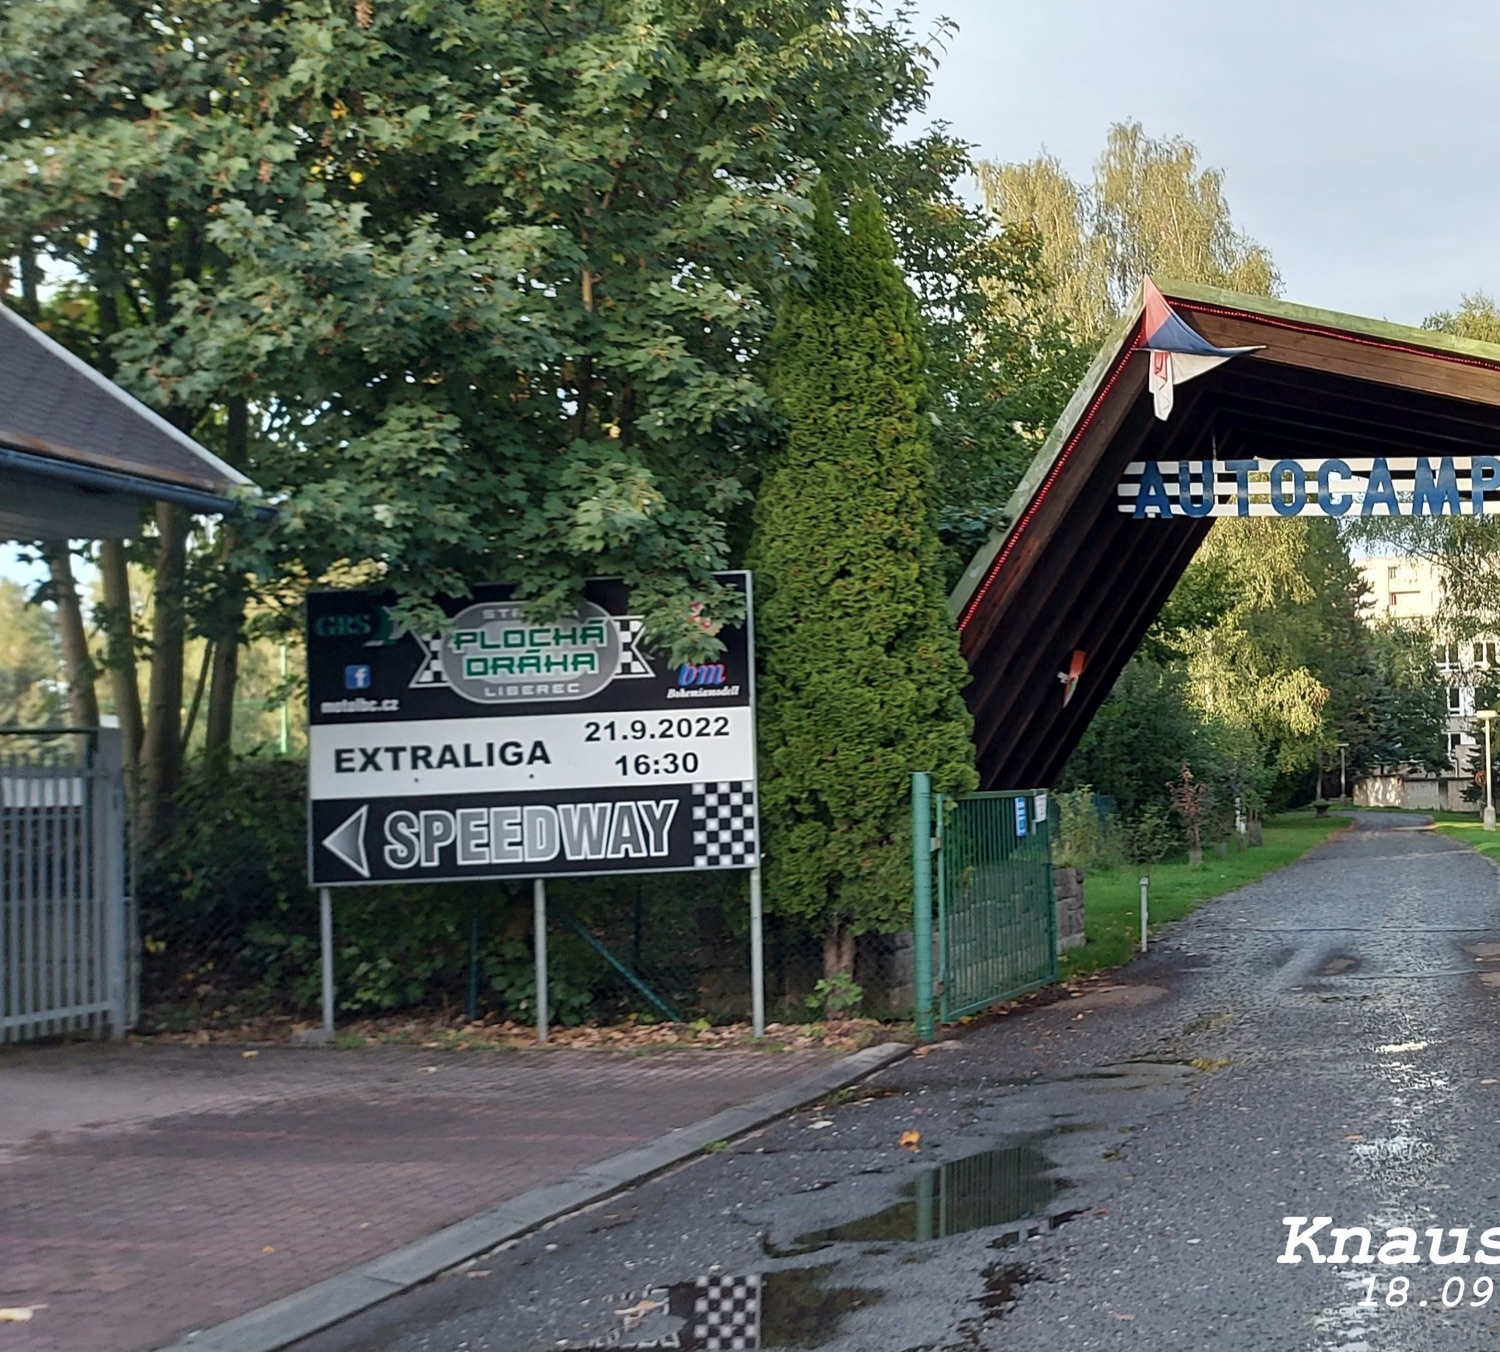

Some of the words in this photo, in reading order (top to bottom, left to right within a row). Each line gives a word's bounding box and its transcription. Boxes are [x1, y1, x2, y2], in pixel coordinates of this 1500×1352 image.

[452, 617, 606, 652] PLOCHÁ
[464, 648, 598, 678] DRÁHA
[484, 682, 580, 697] LIBEREC
[584, 716, 730, 742] 21.9.2022
[334, 740, 552, 774] EXTRALIGA
[614, 751, 700, 776] 16:30
[383, 799, 680, 870] SPEEDWAY
